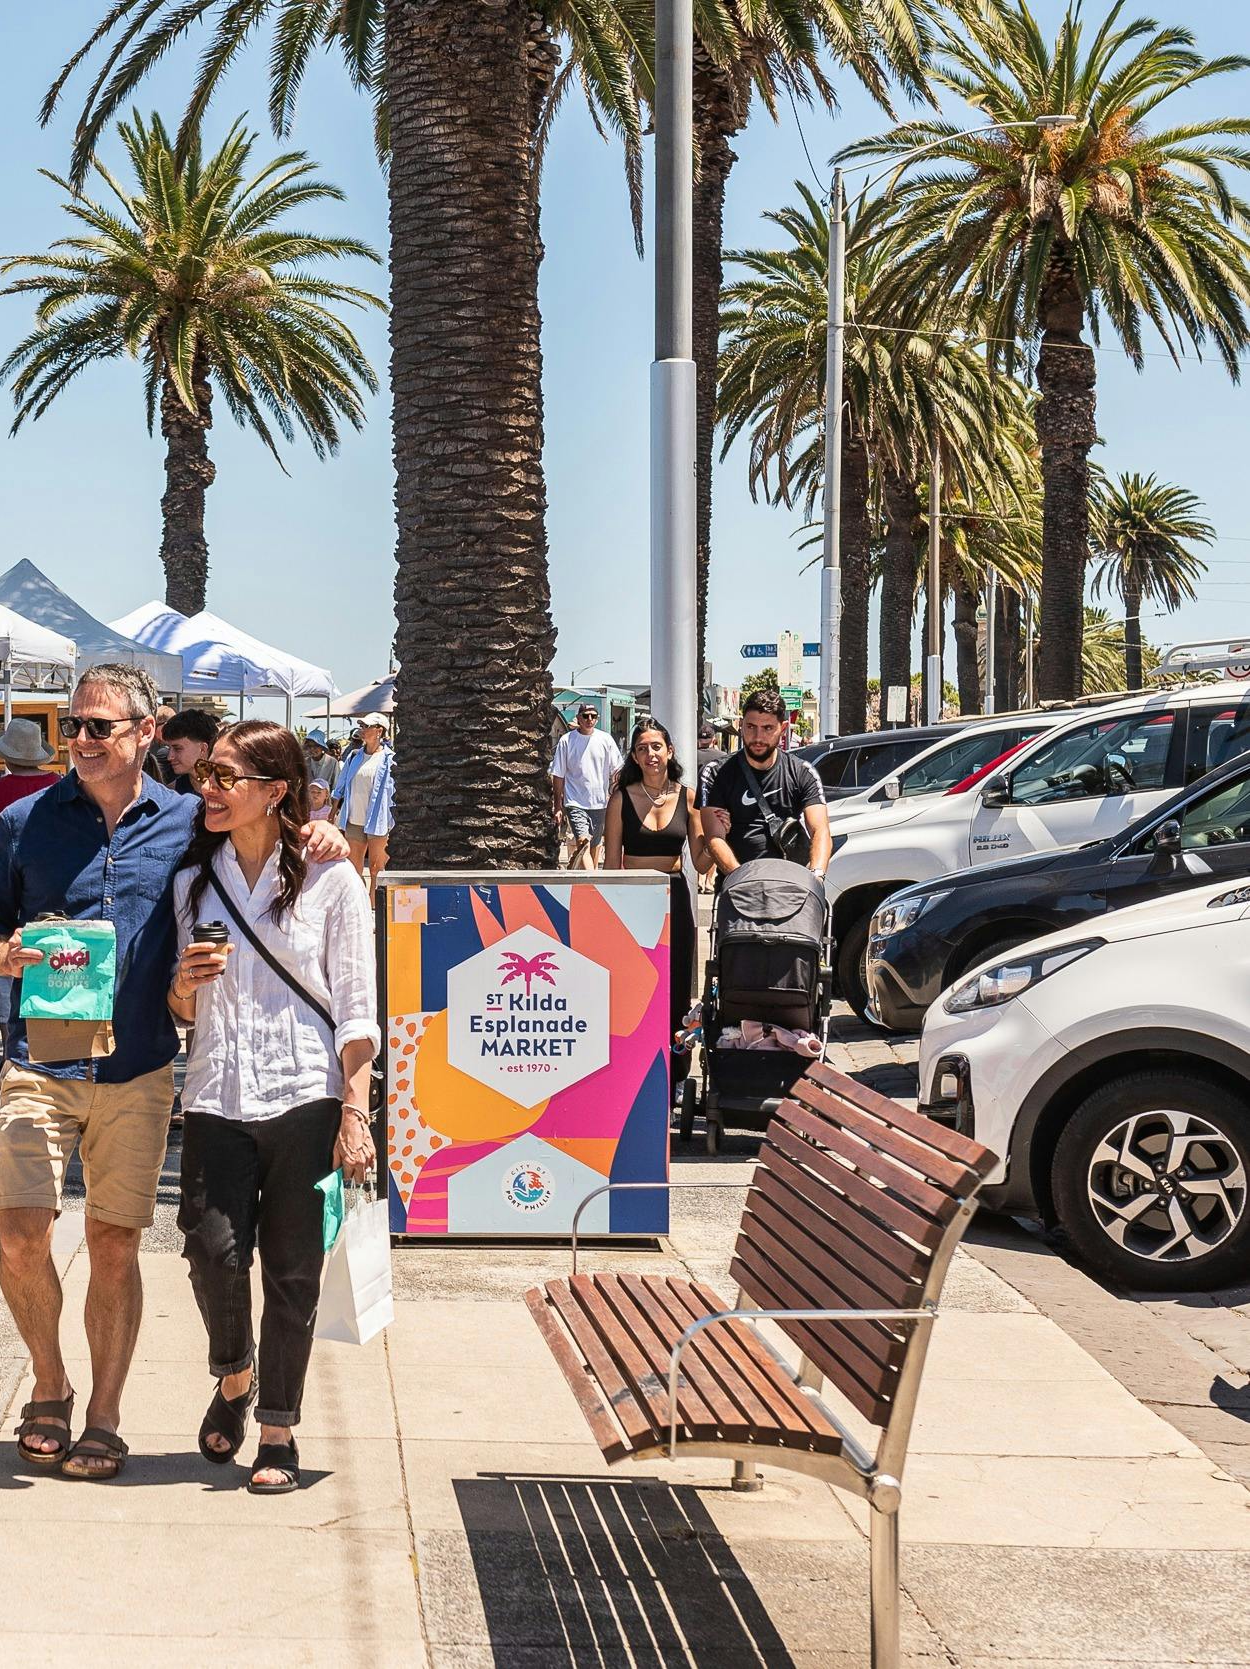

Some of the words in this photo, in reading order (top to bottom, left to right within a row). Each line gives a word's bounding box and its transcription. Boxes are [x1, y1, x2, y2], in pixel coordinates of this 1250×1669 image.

[48, 980, 89, 989] DONUTS
[486, 993, 504, 1005] ST
[509, 993, 567, 1011] Kilda
[470, 1015, 588, 1037] Esplanade
[481, 1039, 577, 1056] MARKET
[507, 1064, 524, 1073] est
[527, 1063, 551, 1073] 1970
[1160, 1177, 1174, 1194] KIA
[505, 1190, 522, 1208] PORT
[524, 1190, 551, 1211] PHILLIP
